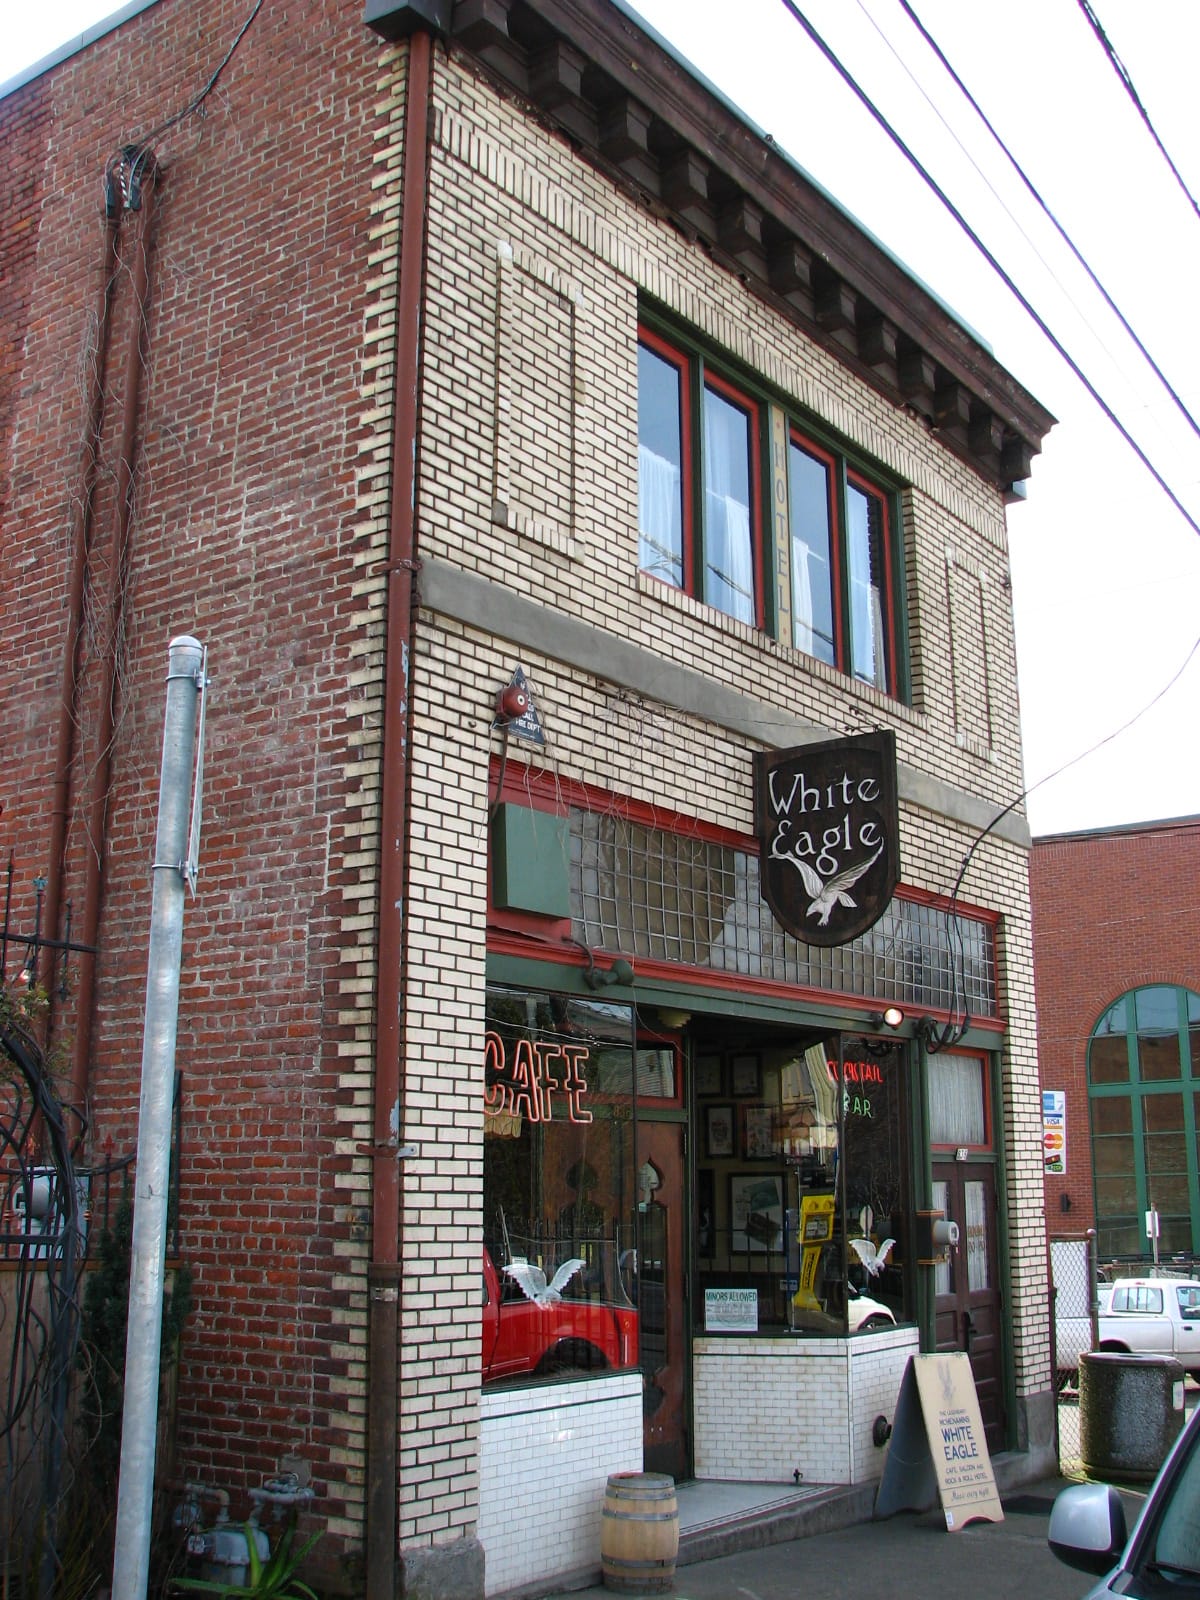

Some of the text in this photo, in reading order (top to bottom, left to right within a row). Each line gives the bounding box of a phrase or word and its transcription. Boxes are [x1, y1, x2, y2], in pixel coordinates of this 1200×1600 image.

[774, 442, 789, 613] HOTEL
[768, 769, 880, 816] White
[771, 813, 881, 876] Eagle
[485, 1031, 593, 1123] CAFE
[729, 1291, 757, 1302] ALLOWED
[941, 1426, 974, 1442] WHITE
[944, 1442, 979, 1460] EAGLE
